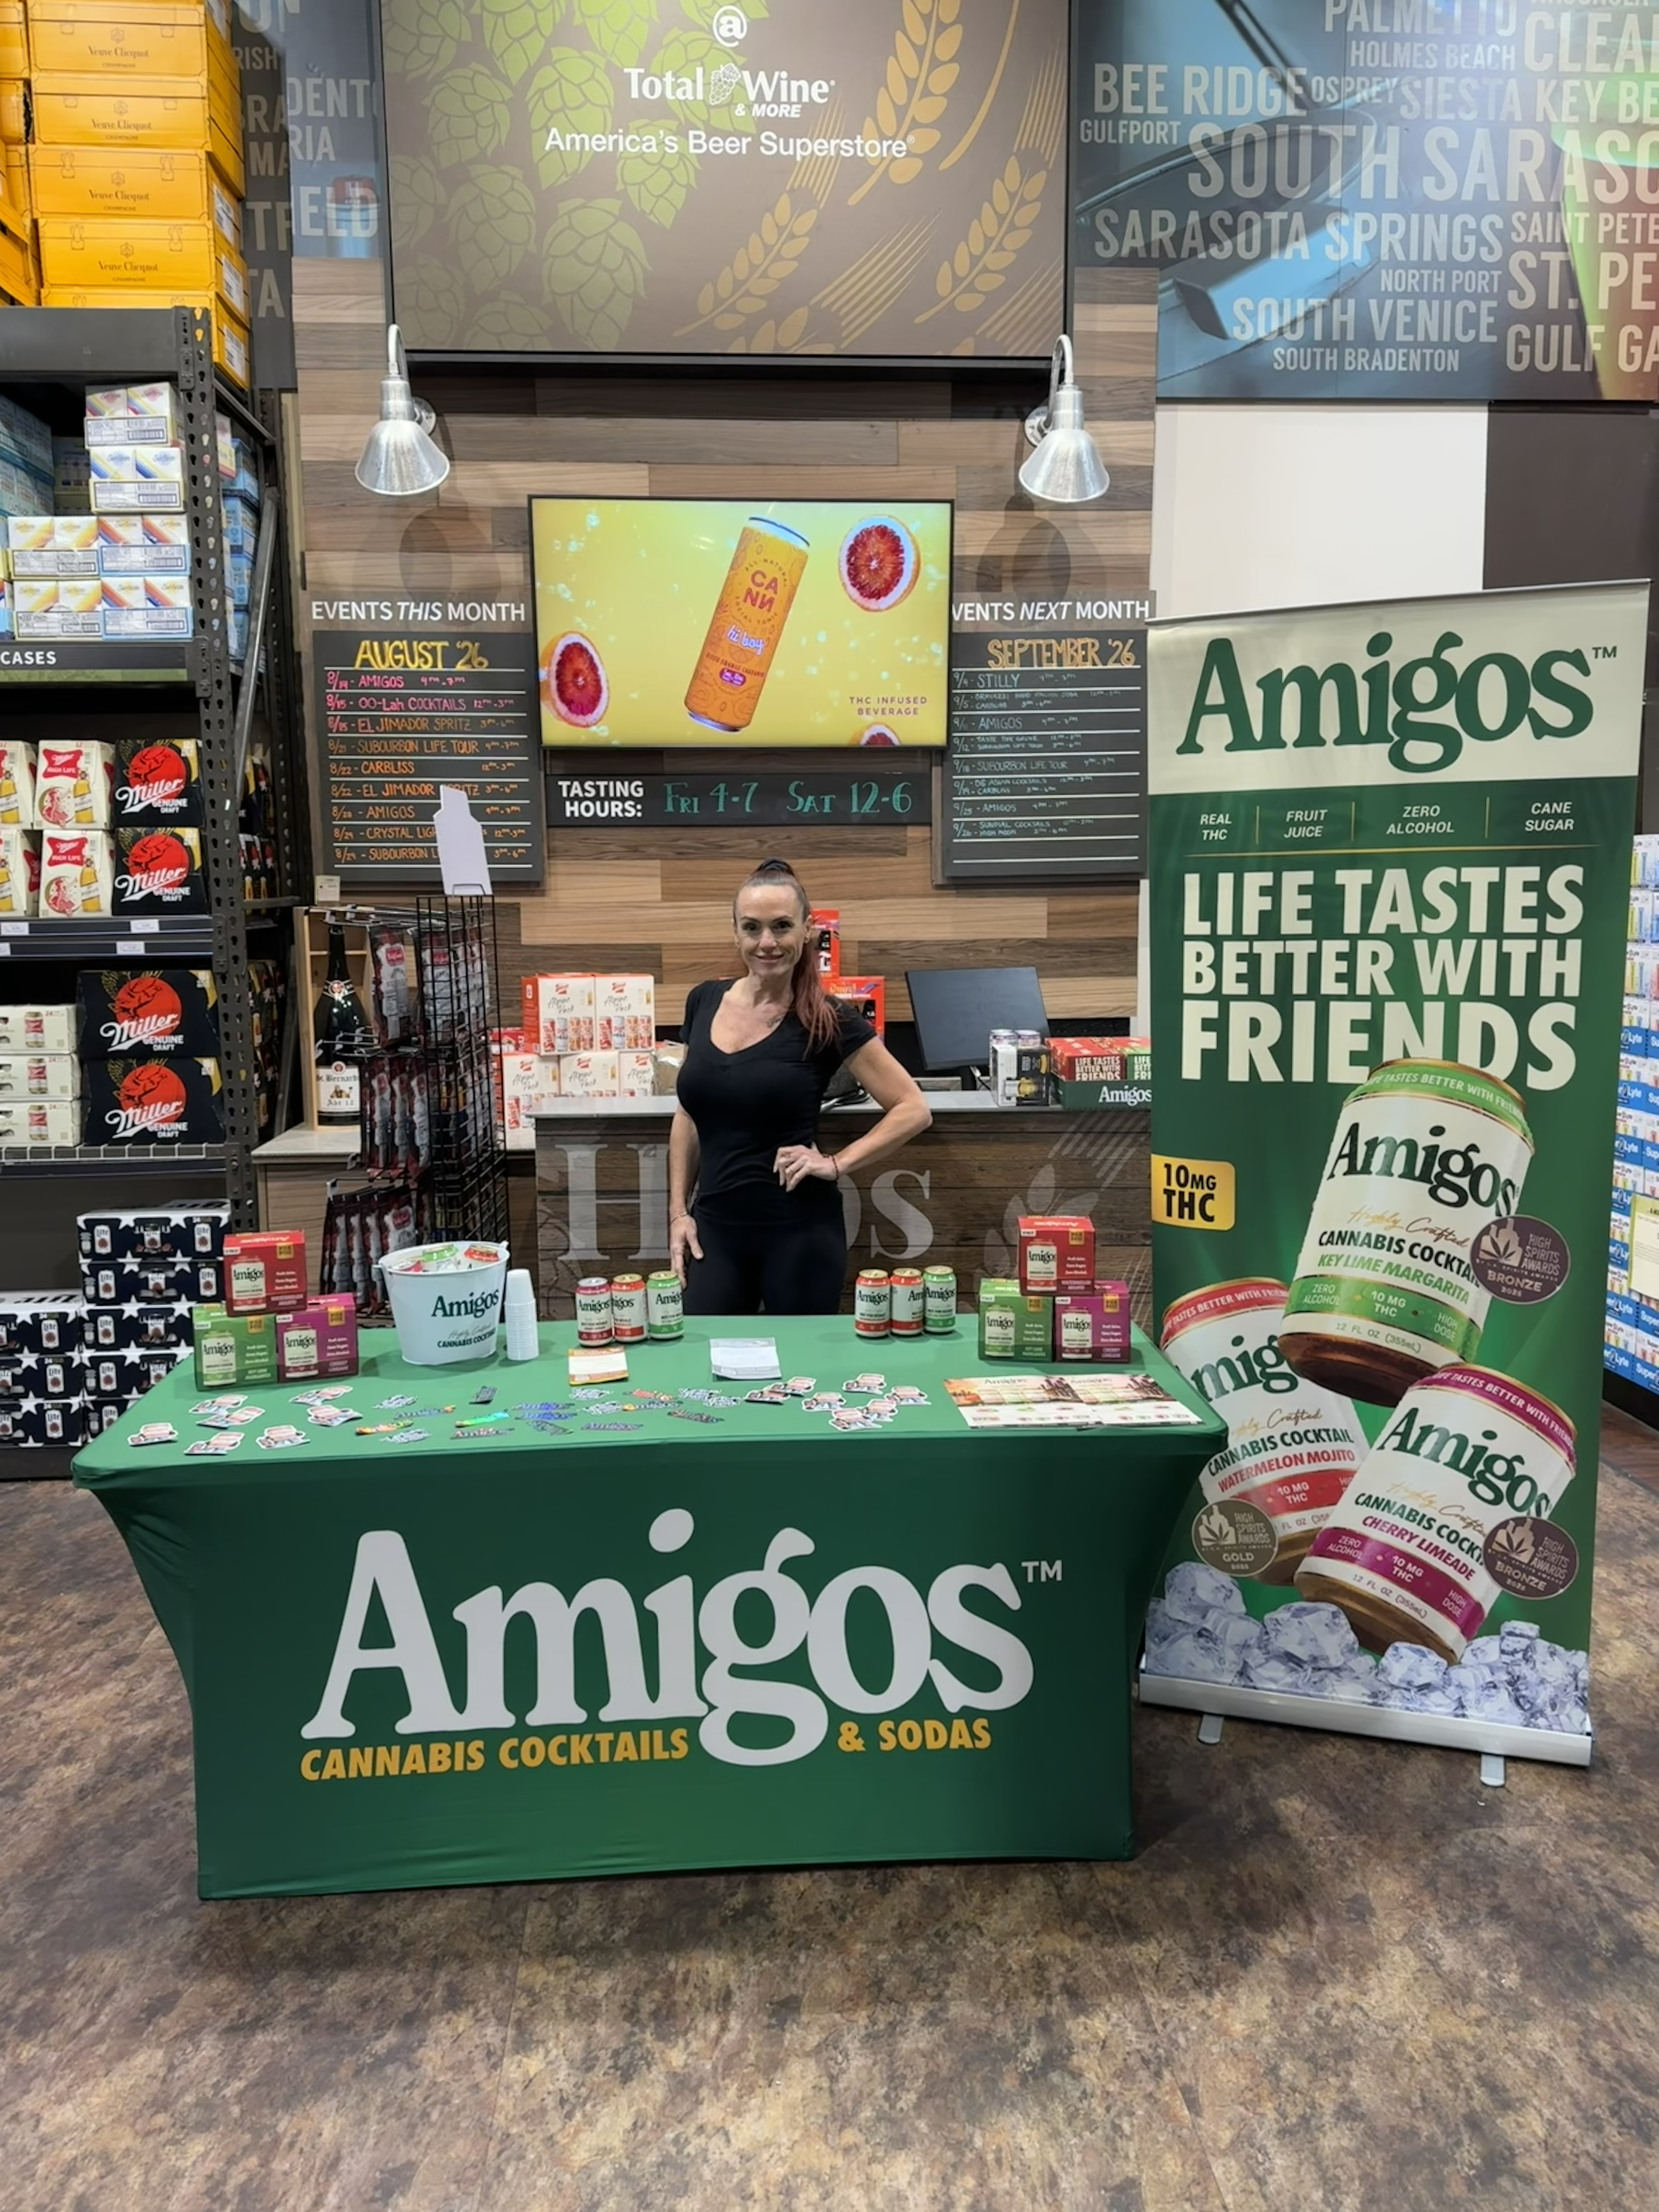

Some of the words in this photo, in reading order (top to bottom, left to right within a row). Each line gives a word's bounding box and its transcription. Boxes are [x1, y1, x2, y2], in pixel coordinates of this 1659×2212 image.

[713, 5, 747, 47] @
[88, 46, 112, 57] Veuve
[115, 47, 149, 58] Clicquot
[1350, 41, 1437, 69] HOLMES
[1446, 43, 1515, 71] BEACH
[624, 67, 704, 100] Total
[1094, 63, 1168, 114] BEE
[1183, 65, 1307, 117] RIDGE
[1311, 76, 1396, 104] OSPREY
[1400, 76, 1523, 121] SIESTA
[1535, 79, 1606, 123] KEY
[735, 105, 745, 116] &
[752, 104, 801, 118] MORE
[91, 118, 115, 130] Veuve
[118, 120, 151, 131] Clicquot
[1080, 119, 1181, 145] GULFPORT
[249, 125, 336, 176] MARIA
[545, 128, 678, 154] America's
[689, 130, 752, 155] Beer
[1188, 122, 1400, 200] SOUTH
[89, 189, 113, 201] Veuve
[115, 191, 149, 201] Clicquot
[1094, 208, 1310, 260] SARASOTA
[1325, 212, 1504, 263] SPRINGS
[1511, 211, 1590, 244] SAINT
[98, 260, 122, 272] Veuve
[124, 262, 158, 272] Clicquot
[1381, 269, 1445, 293] NORTH
[1451, 270, 1502, 294] PORT
[1507, 250, 1578, 309] ST.
[1598, 251, 1657, 310] PE
[1232, 297, 1355, 342] SOUTH
[1369, 299, 1498, 343] VENICE
[1506, 324, 1605, 373] GULF
[1273, 347, 1337, 371] SOUTH
[1344, 348, 1460, 372] BRADENTON
[311, 601, 393, 620] EVENTS
[397, 601, 442, 621] THIS
[448, 602, 525, 622] MONTH
[952, 602, 1015, 620] VENTS
[1020, 601, 1072, 620] NEXT
[1076, 600, 1149, 619] MONTH
[0, 651, 57, 666] CASES
[354, 640, 449, 670] AUGUST
[987, 637, 1100, 669] SEPTEMBER
[358, 675, 404, 688] AMIGOS
[976, 673, 1020, 688] STILLY
[408, 697, 466, 711] COCKTAILS
[849, 696, 872, 705] THC
[876, 696, 927, 704] INFUSED
[1176, 631, 1594, 774] Amigos
[857, 707, 919, 715] BEVERAGE
[357, 718, 375, 733] EL
[376, 718, 429, 732] JIMADOR
[434, 718, 471, 731] SPRITZ
[979, 717, 1023, 729] AMIGOS
[357, 739, 418, 753] SUBOURBON
[423, 740, 448, 752] LIFE
[450, 740, 479, 754] TOUR
[361, 761, 415, 774] CARBLISS
[977, 761, 1027, 771] SUBOURBON
[1030, 761, 1046, 769] LIFE
[1048, 761, 1068, 769] TOUR
[116, 778, 186, 815] Miller
[362, 785, 379, 797] EL
[381, 783, 436, 796] JIMADOR
[558, 781, 644, 797] TASTING
[709, 782, 759, 813] 4-7
[849, 782, 912, 813] 12-6
[366, 805, 415, 819] AMIGOS
[564, 800, 643, 817] HOURS:
[982, 804, 1016, 812] AMIGOS
[1285, 809, 1328, 823] FRUIT
[1402, 805, 1441, 818] ZERO
[1530, 801, 1571, 816] CANE
[1199, 813, 1233, 826] REAL
[1386, 821, 1455, 836] ALCOHOL
[1524, 817, 1575, 833] SUGAR
[366, 828, 414, 839] CRYSTAL
[1201, 828, 1228, 842] THC
[1284, 824, 1324, 840] JUICE
[369, 848, 428, 860] SUBOURBON
[115, 867, 187, 903] Miller
[1182, 870, 1315, 937] LIFE
[1335, 864, 1584, 935] TASTES
[1182, 939, 1396, 996] BETTER
[1413, 939, 1582, 997] WITH
[100, 1012, 180, 1052] Miller
[143, 1034, 184, 1045] GENUINE
[1181, 1000, 1577, 1091] FRIENDS
[1075, 1058, 1092, 1066] LIFE
[1093, 1056, 1120, 1065] TASTES
[1076, 1072, 1121, 1080] FRIENDS
[1099, 1085, 1152, 1106] Amigos
[104, 1101, 184, 1139] Miller
[1163, 1163, 1217, 1191] 10MG
[1163, 1188, 1215, 1222] THC
[96, 1228, 109, 1237] Lite
[1528, 1233, 1552, 1249] HIGH
[1318, 1230, 1405, 1255] CANNABIS
[1525, 1246, 1560, 1263] SPIRITS
[1521, 1258, 1561, 1276] AWARDS
[1317, 1253, 1343, 1269] KEY
[1344, 1256, 1383, 1273] LIME
[1382, 1257, 1470, 1305] MARGARITA
[1487, 1270, 1542, 1292] BRONZE
[431, 1289, 499, 1318] Amigos
[857, 1290, 888, 1305] Amigos
[925, 1287, 955, 1301] Amigos
[579, 1300, 610, 1314] Amigos
[437, 1337, 472, 1348] CANNABIS
[1207, 1435, 1278, 1477] CANNABIS
[1280, 1428, 1355, 1448] COCKTAIL
[1218, 1453, 1305, 1494] WATERMELON
[1307, 1449, 1355, 1464] MOJITO
[1361, 1515, 1417, 1544] CHERRY
[1417, 1534, 1476, 1581] LIMEADE
[1222, 1553, 1254, 1563] GOLD
[1495, 1560, 1547, 1591] BRONZE
[300, 1508, 1034, 1766] Amigos
[300, 1740, 486, 1781] CANNABIS
[497, 1727, 690, 1770] COCKTAILS
[836, 1722, 866, 1753] &
[877, 1717, 992, 1751] SODAS
